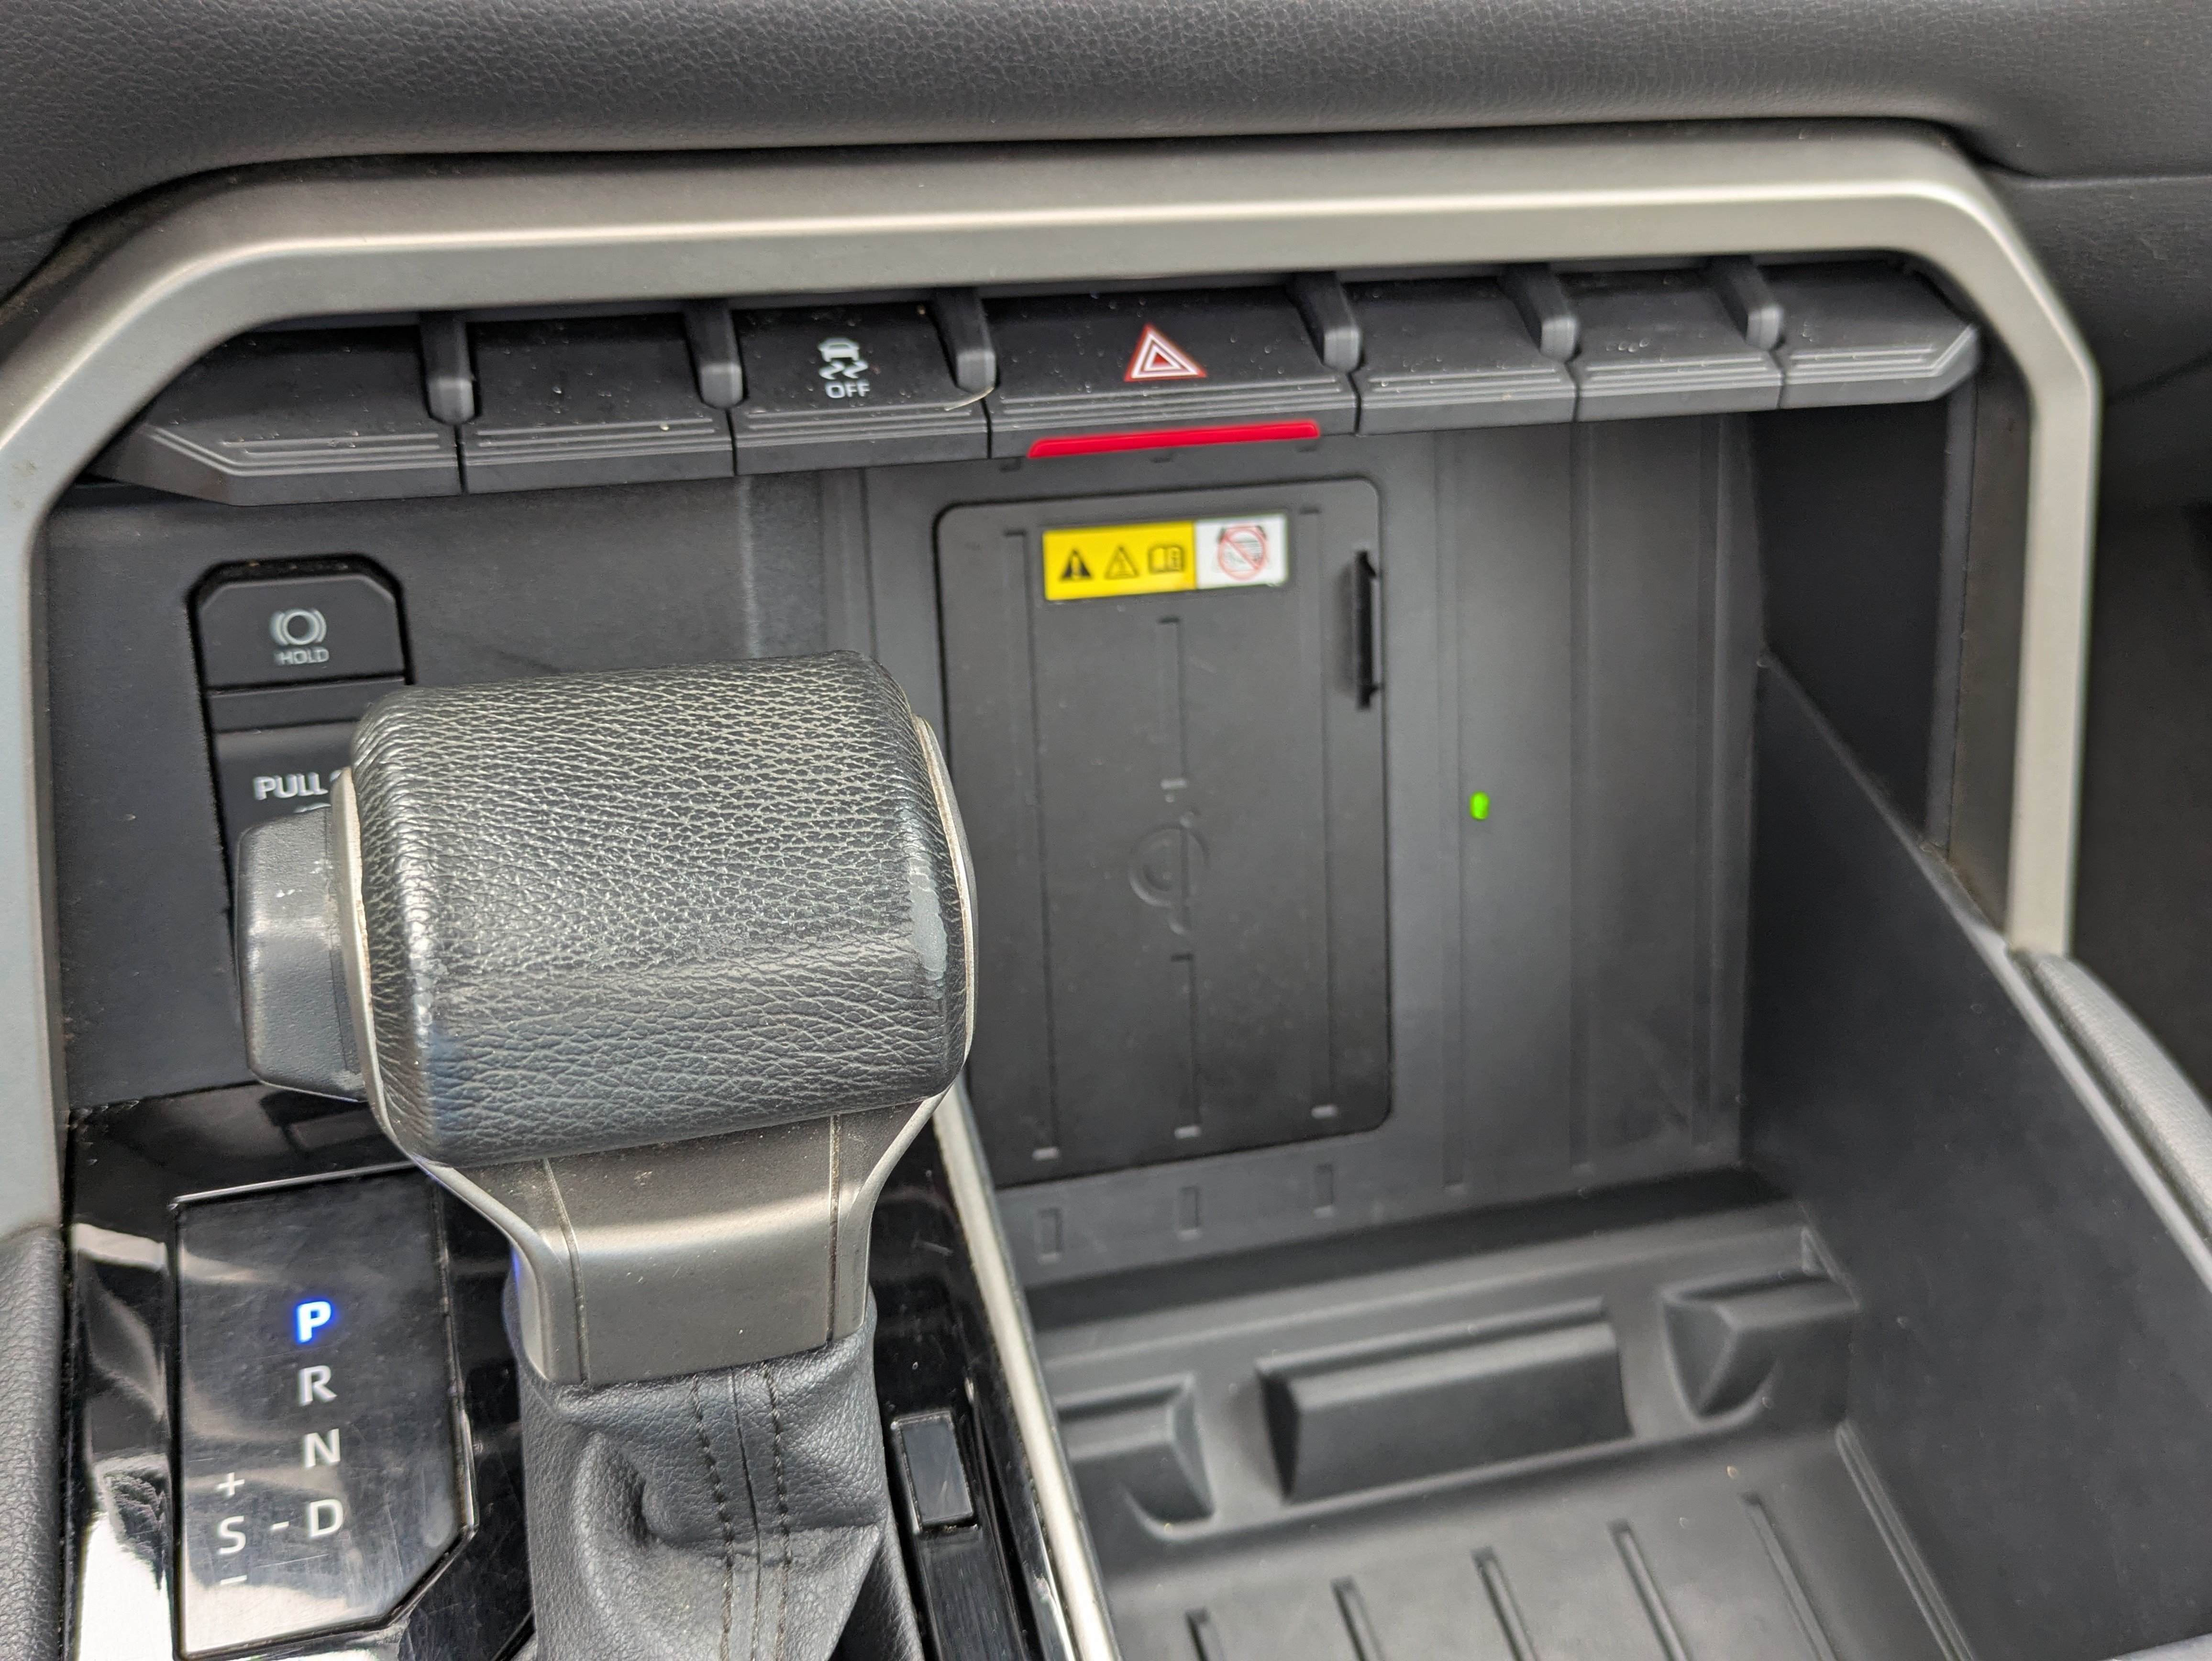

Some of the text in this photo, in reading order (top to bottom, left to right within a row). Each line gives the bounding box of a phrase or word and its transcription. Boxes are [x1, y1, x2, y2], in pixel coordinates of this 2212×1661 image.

[824, 379, 871, 399] OFF
[275, 647, 330, 666] HOLD
[253, 772, 329, 800] PULL
[297, 1300, 332, 1343] P
[298, 1364, 337, 1406] R
[303, 1428, 341, 1468] N
[218, 1515, 246, 1556] S
[307, 1499, 344, 1538] D
